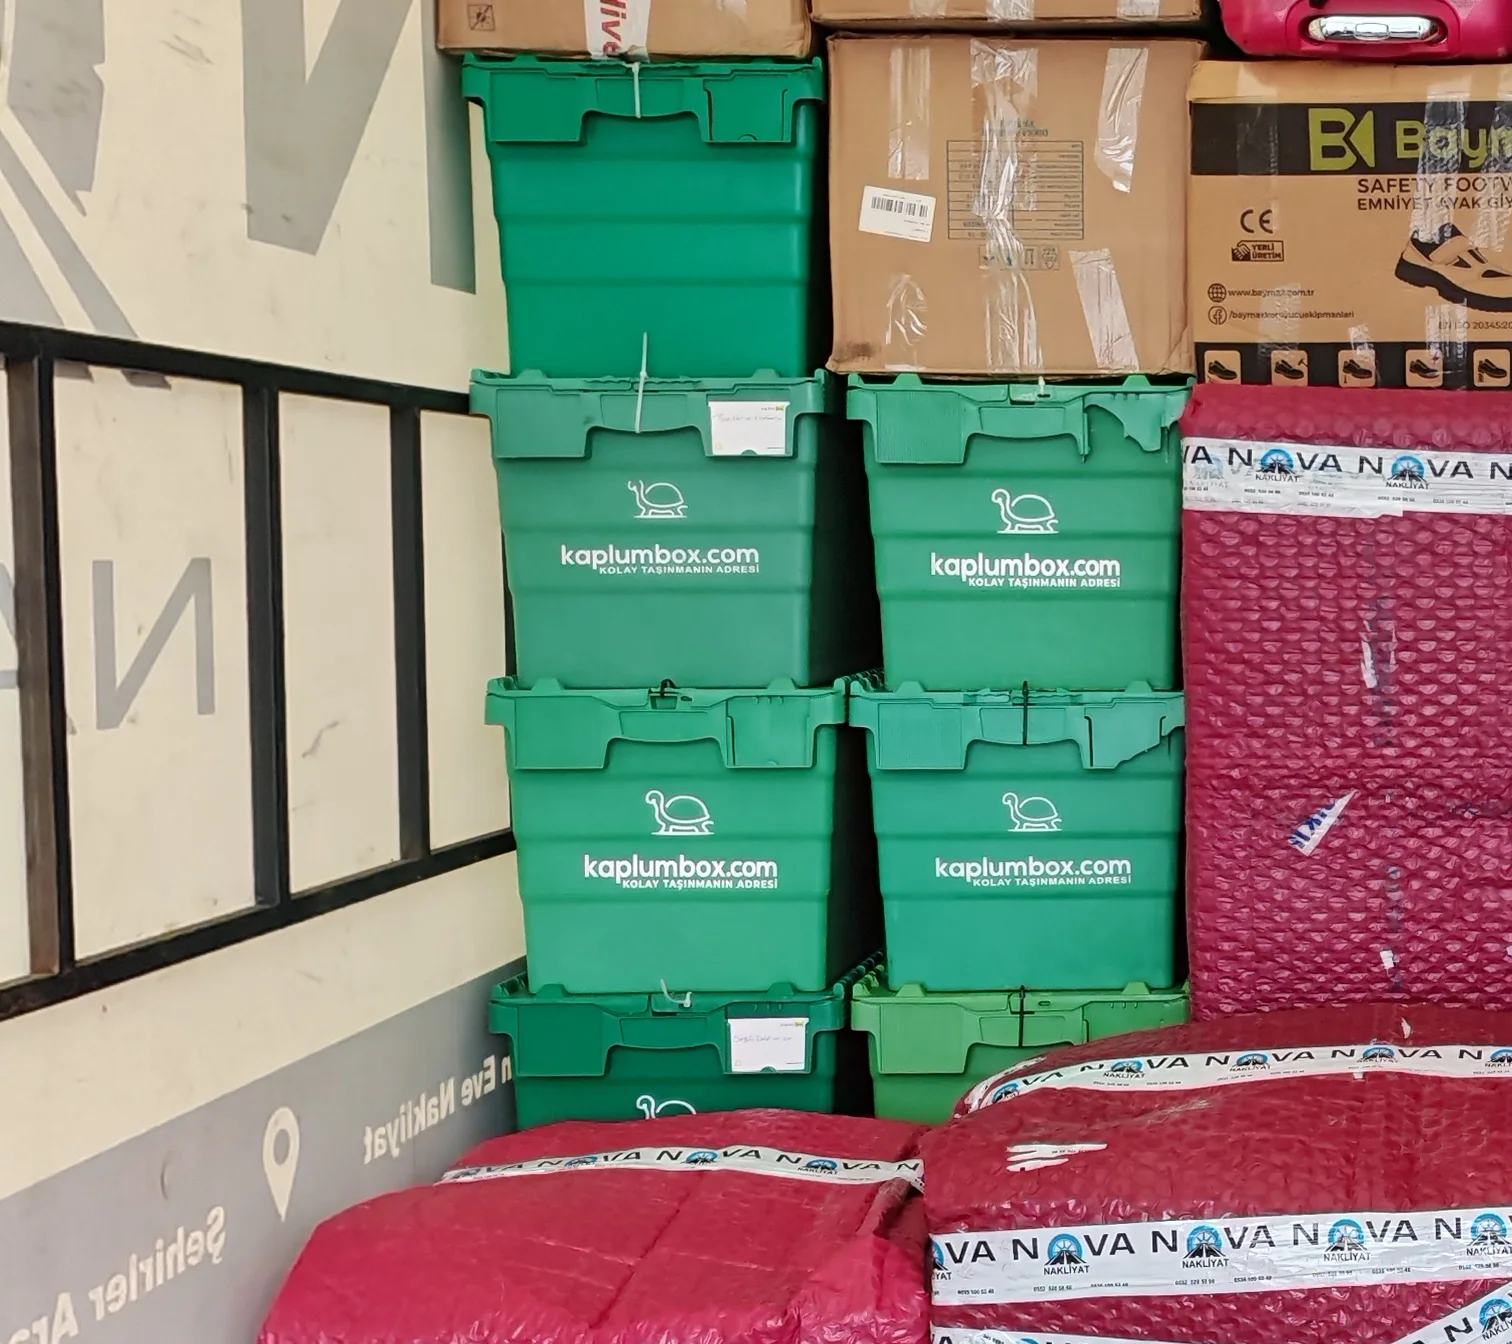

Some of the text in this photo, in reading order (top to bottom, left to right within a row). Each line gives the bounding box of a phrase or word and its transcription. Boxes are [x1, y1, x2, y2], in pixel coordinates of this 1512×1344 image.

[1357, 176, 1434, 194] SAFETY
[1251, 242, 1275, 252] YERLİ
[1251, 250, 1282, 260] ÜRETİM
[561, 543, 760, 570] kaplumbox.com
[600, 564, 760, 576] KOLAY TAŞINMANIN ADRESİ
[930, 552, 1120, 582] kaplumbox.com
[968, 577, 1121, 589] KOLAY TAŞINMANIN ADRESİ
[584, 853, 778, 884] kaplumbox.com
[935, 855, 1132, 883] kaplumbox.com
[622, 878, 778, 890] KOLAY TAŞINMANIN ADRESİ
[973, 874, 1131, 887] KOLAY TAŞINMANIN ADRESİ
